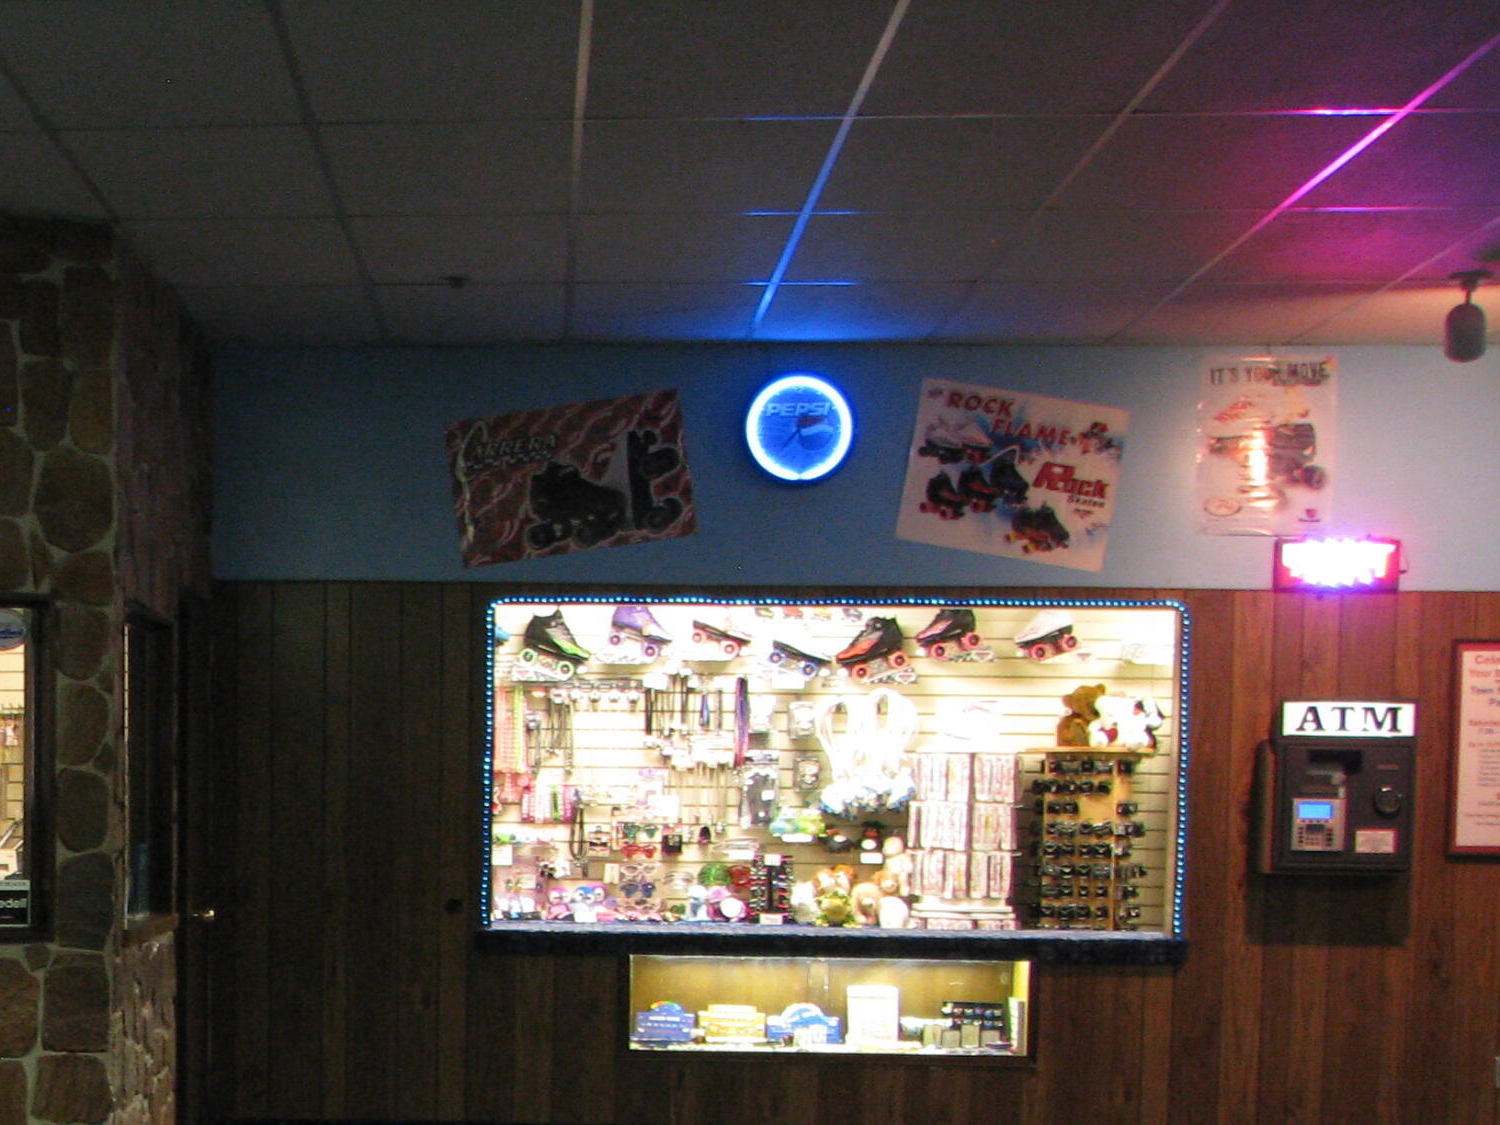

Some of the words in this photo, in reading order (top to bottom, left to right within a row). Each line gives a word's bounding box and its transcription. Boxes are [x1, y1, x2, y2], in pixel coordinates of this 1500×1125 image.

[765, 402, 831, 416] PEPSI
[946, 389, 1015, 416] ROCK
[1295, 705, 1403, 732] ATM
